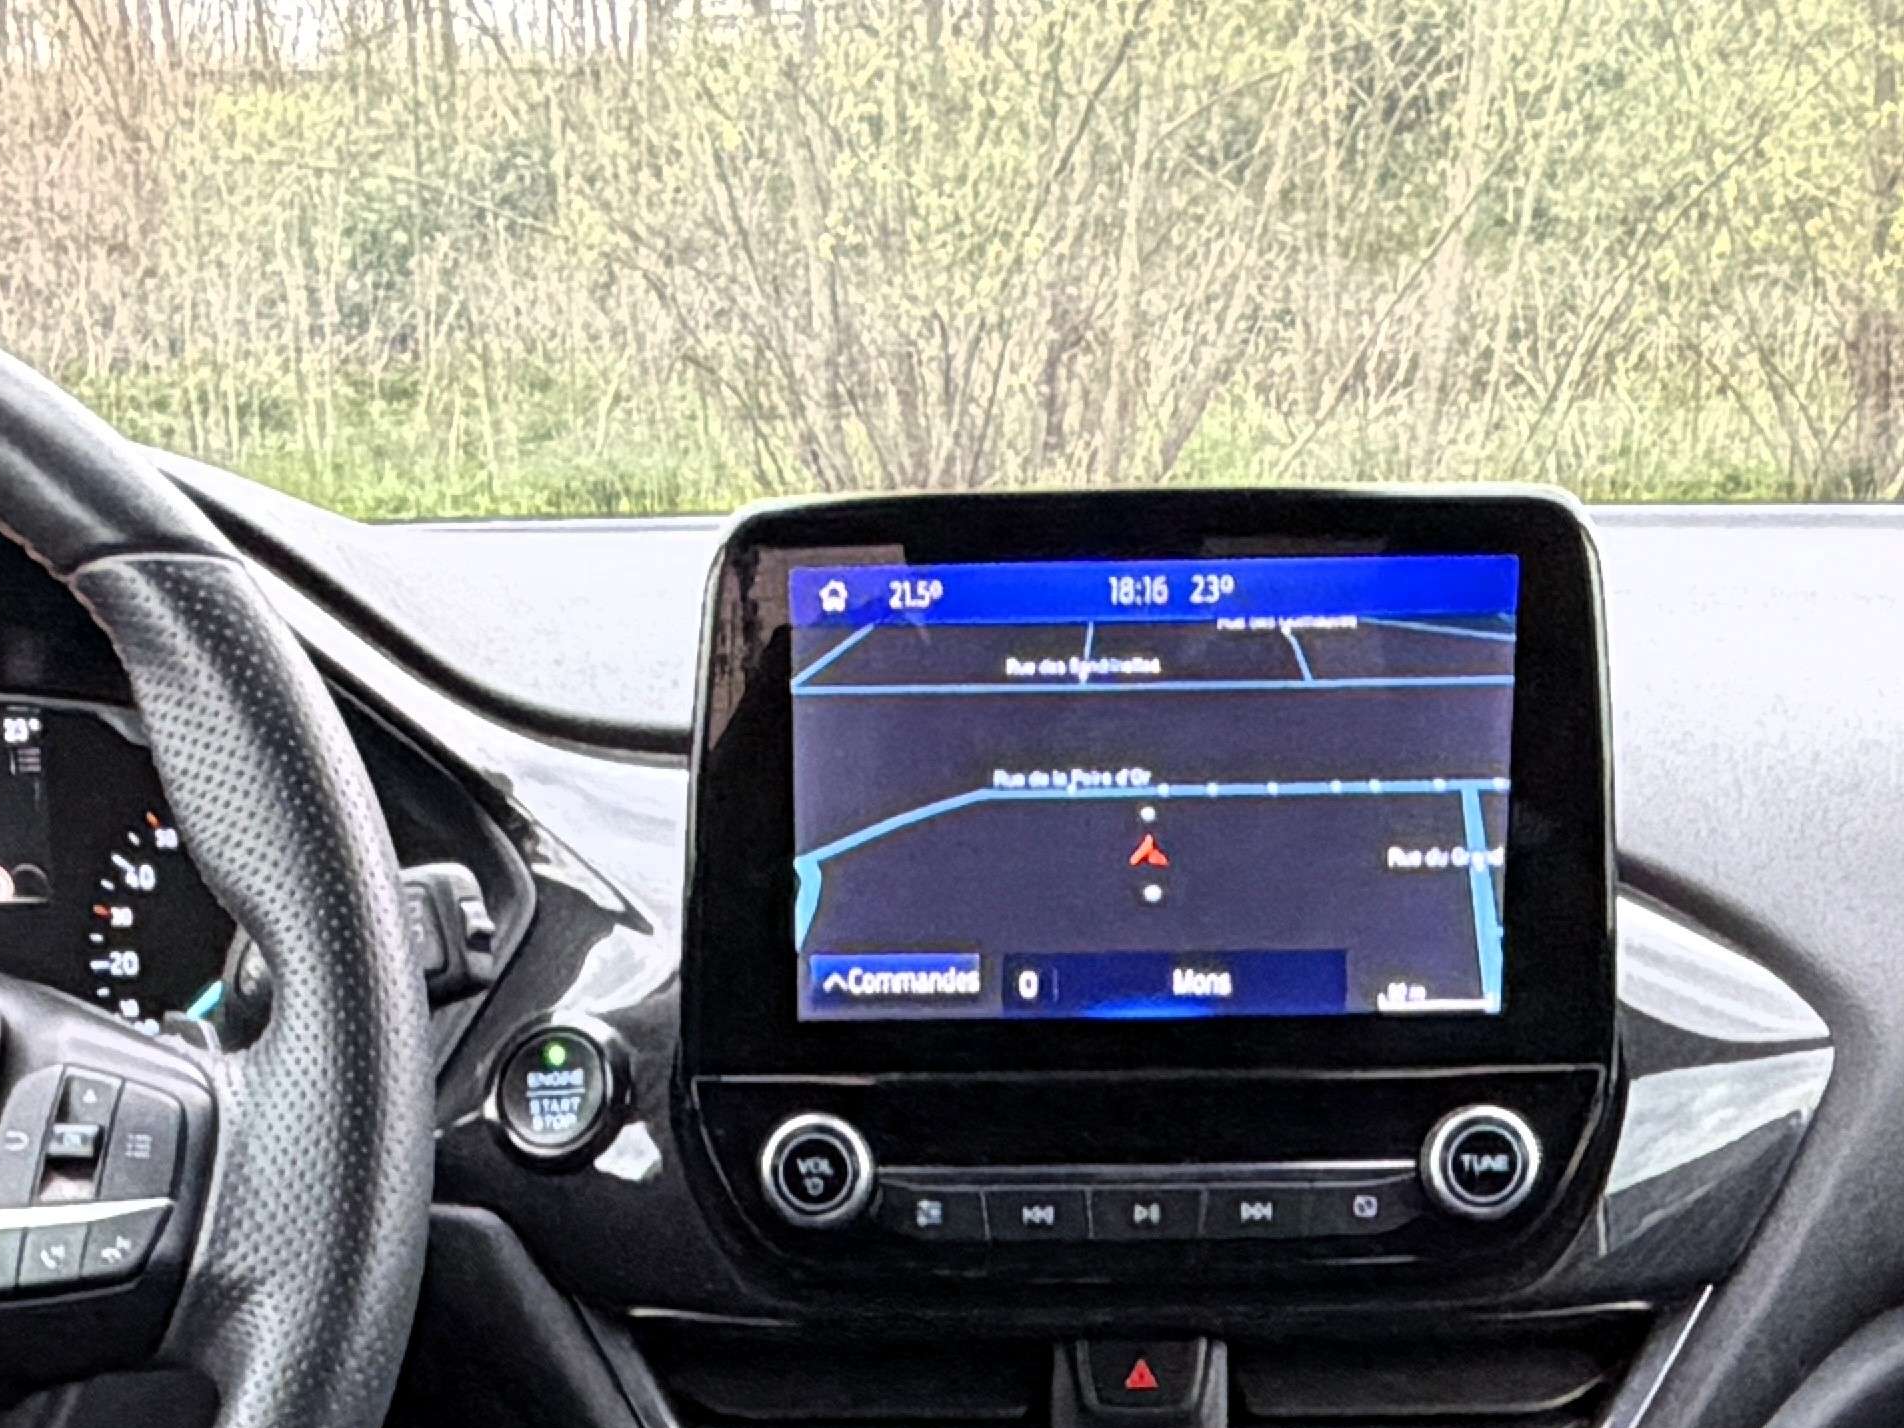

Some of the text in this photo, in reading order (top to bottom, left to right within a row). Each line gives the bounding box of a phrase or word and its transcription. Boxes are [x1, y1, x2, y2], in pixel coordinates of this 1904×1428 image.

[1108, 574, 1169, 606] 18:16
[1006, 656, 1036, 675] Rue
[992, 767, 1026, 788] Rue
[109, 950, 140, 977] 20
[848, 966, 981, 996] Commandes
[1172, 967, 1232, 997] Mons
[526, 1067, 584, 1088] ENGINE
[529, 1096, 581, 1115] START
[531, 1111, 578, 1131] STOP
[796, 1156, 834, 1176] VOL
[1459, 1152, 1510, 1177] TUNE
